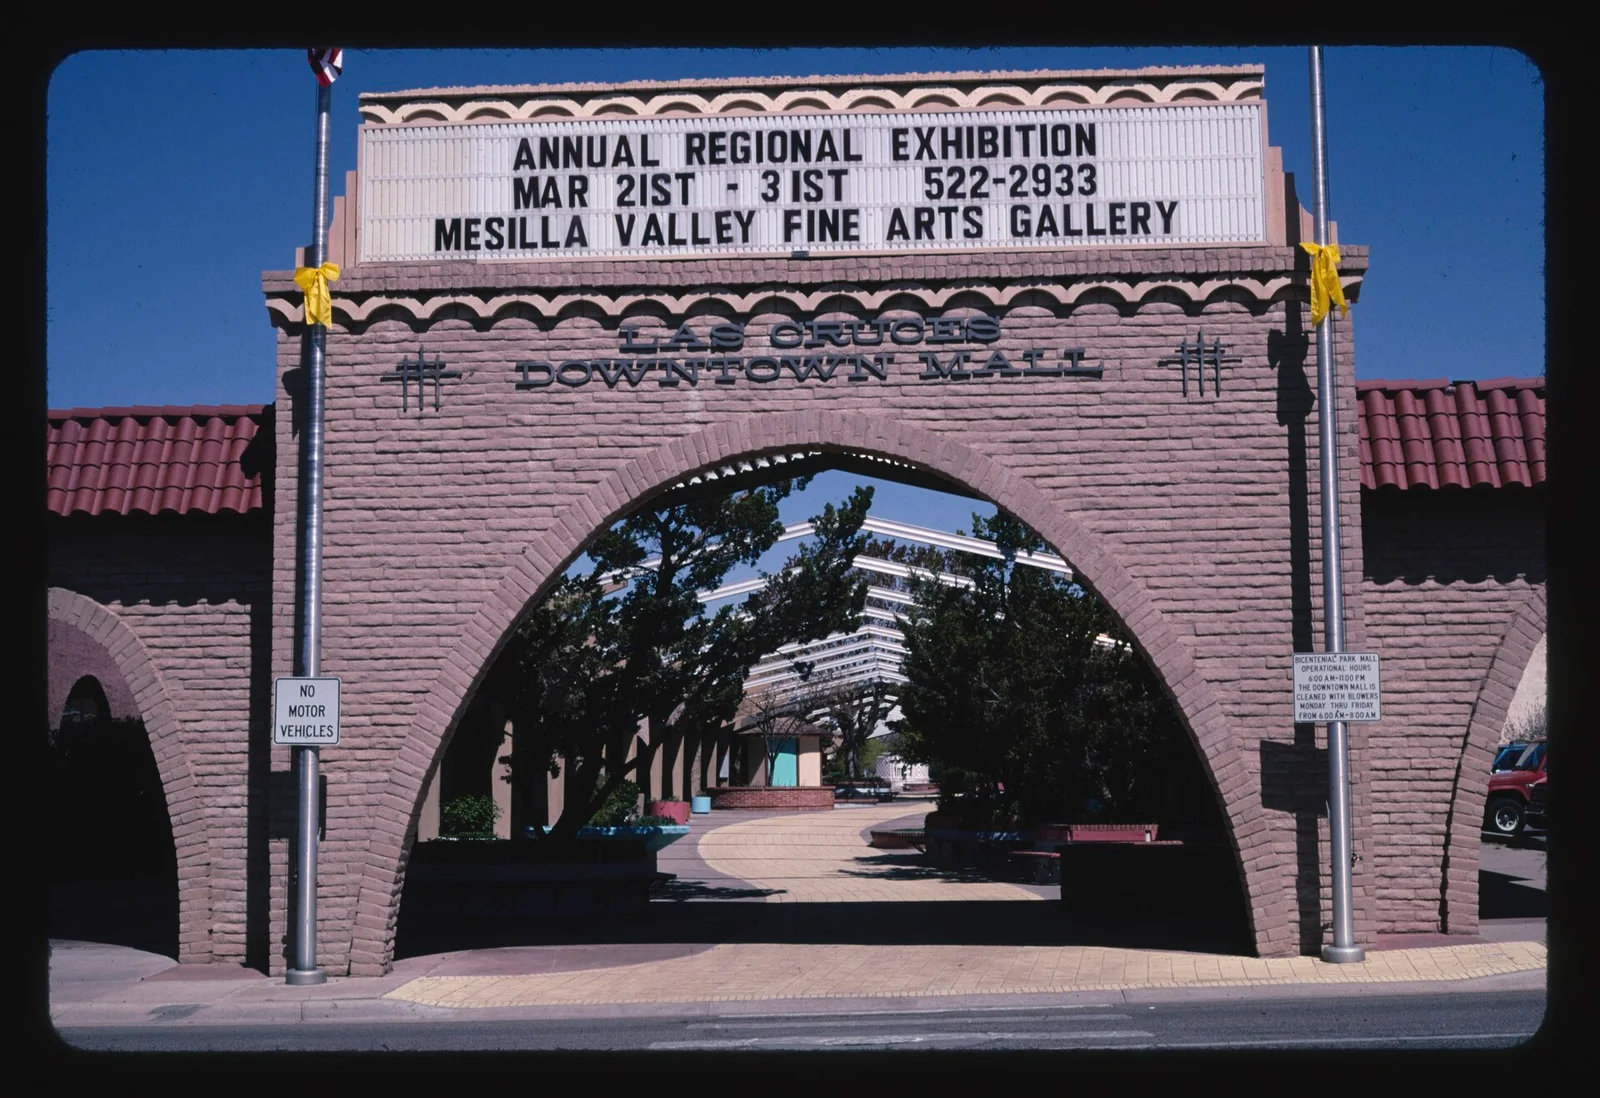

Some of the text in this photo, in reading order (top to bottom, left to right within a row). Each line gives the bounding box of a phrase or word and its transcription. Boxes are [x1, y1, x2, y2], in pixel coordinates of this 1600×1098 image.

[513, 123, 1096, 171] ANNUAL REGIONAL EXHIBITION
[513, 173, 589, 210] MAR
[924, 163, 1097, 200] 522-2933
[435, 201, 1179, 251] MESILLA VALLEY FINE ARTS GALLERY
[619, 315, 1001, 353] LAS CRUCES
[515, 347, 1104, 390] DOWNTOWN MALL
[300, 684, 315, 698] NO
[1348, 692, 1379, 700] BLOWERS
[288, 704, 326, 718] MOTOR
[280, 724, 334, 738] VEHICLES
